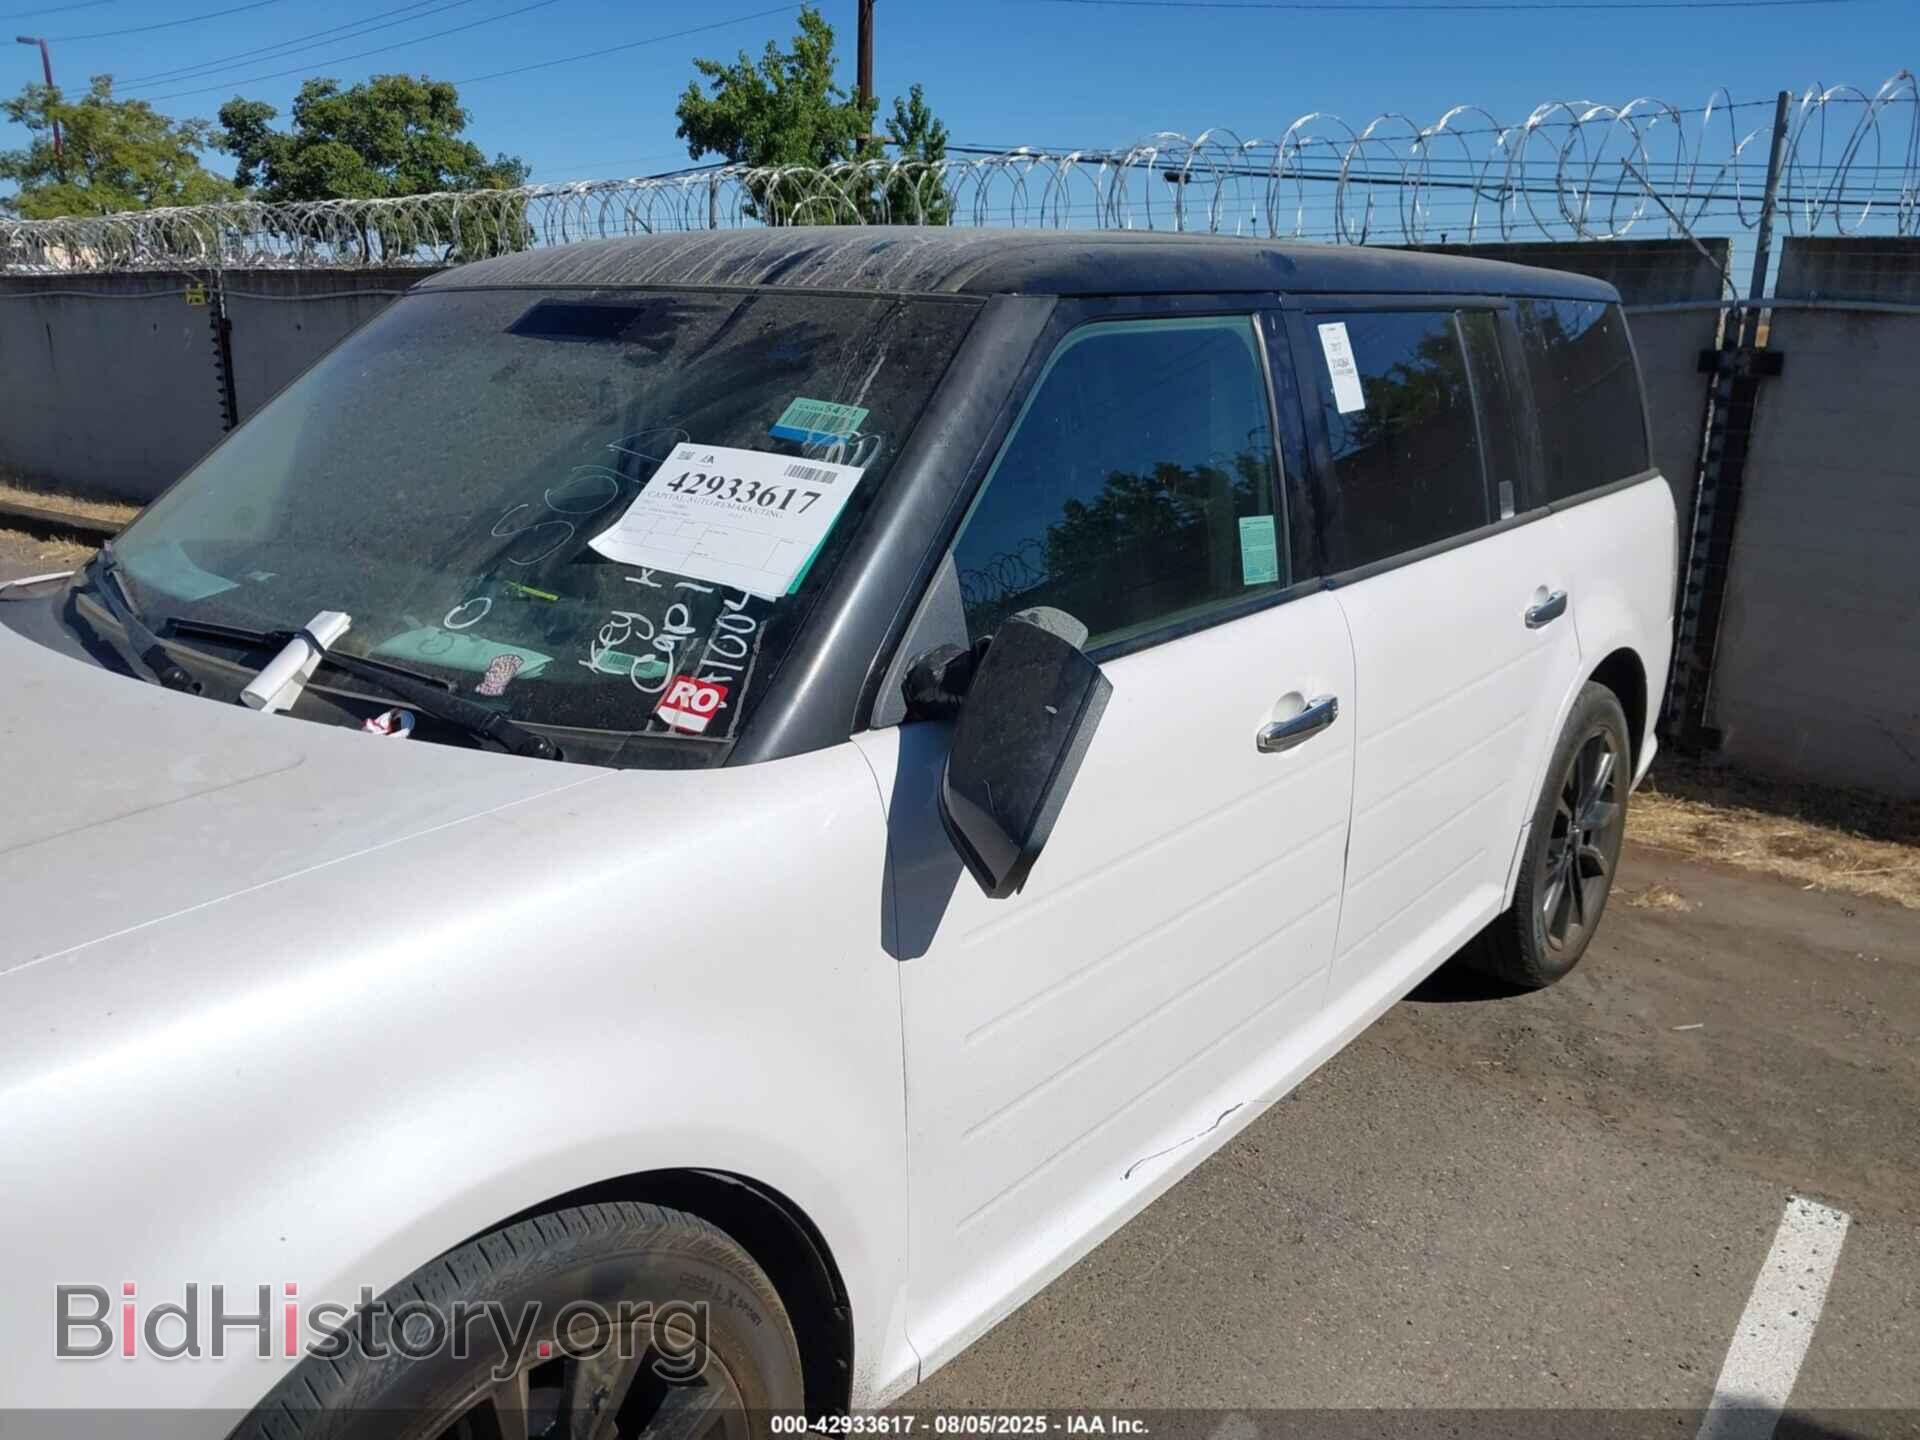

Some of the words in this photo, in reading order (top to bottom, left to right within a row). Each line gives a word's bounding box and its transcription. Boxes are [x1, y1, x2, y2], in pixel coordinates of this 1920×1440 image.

[647, 491, 686, 502] CAPITAL
[687, 496, 712, 506] AUTO
[712, 499, 784, 519] REMARKETING
[667, 471, 822, 514] 42933617
[579, 610, 654, 675] Key
[631, 603, 696, 693] Cap
[667, 680, 720, 713] RO
